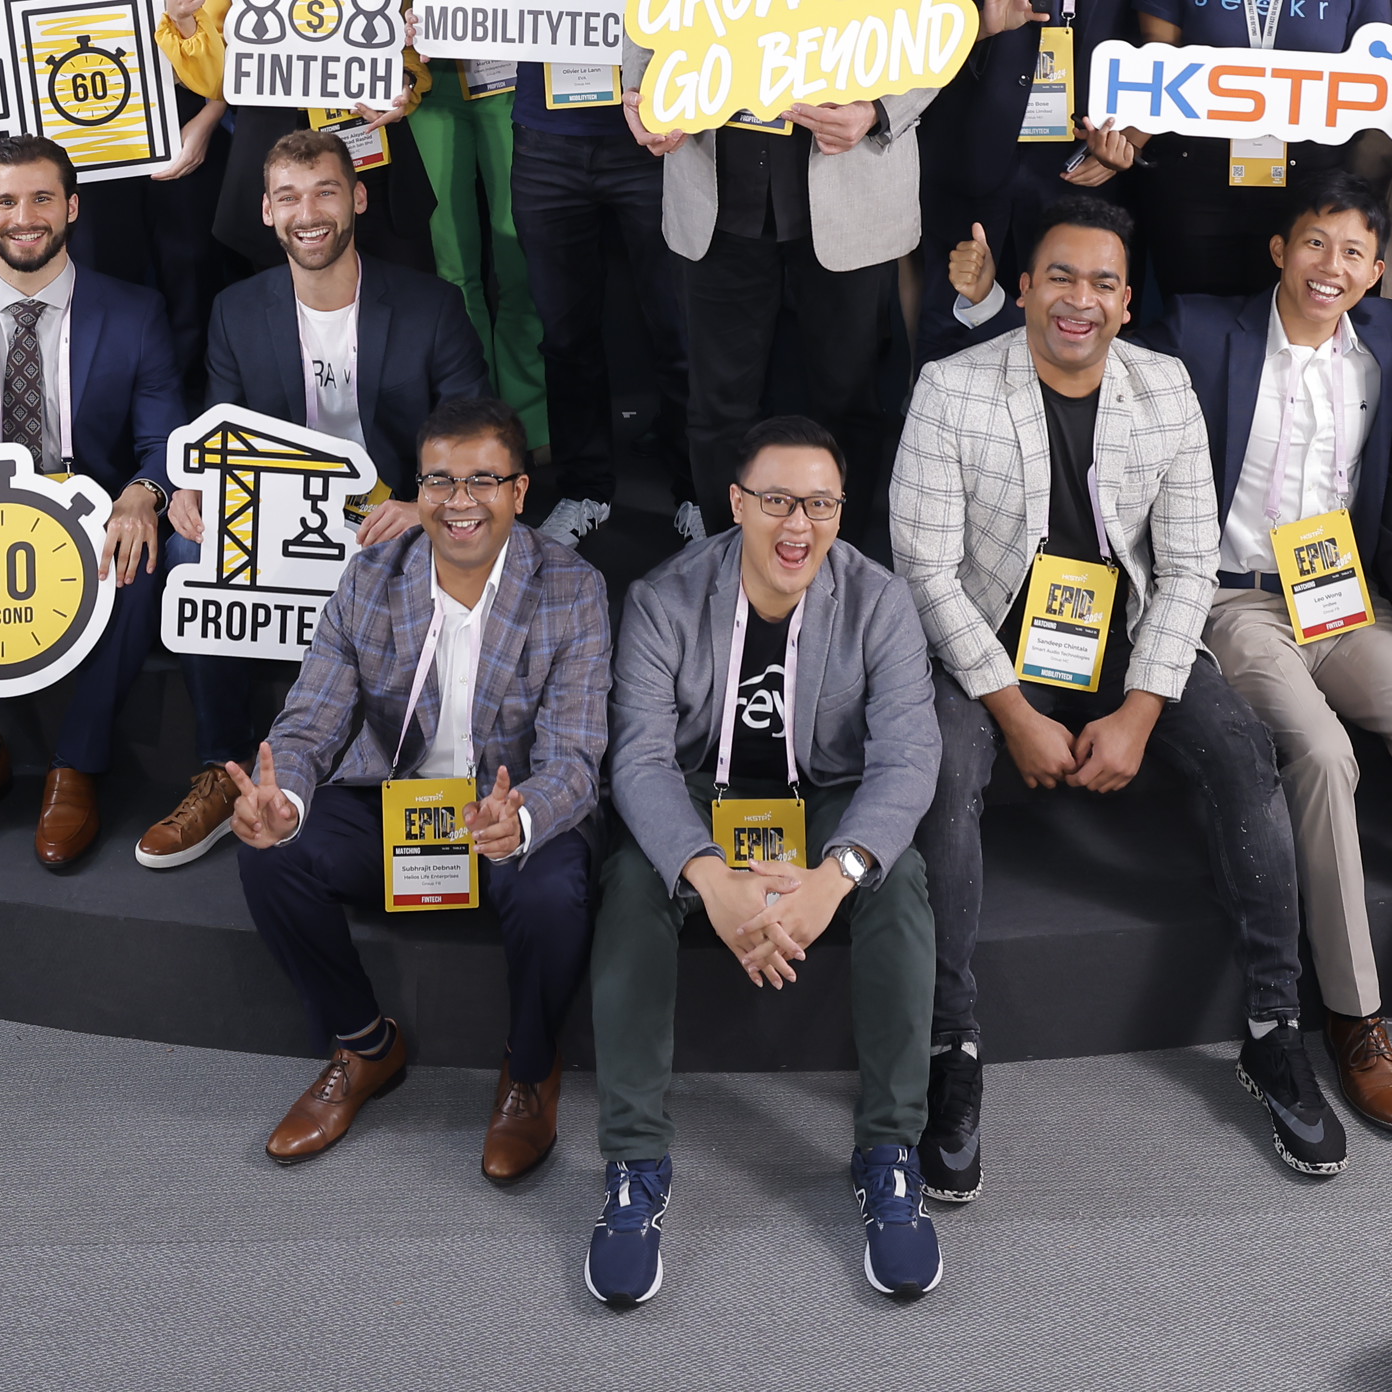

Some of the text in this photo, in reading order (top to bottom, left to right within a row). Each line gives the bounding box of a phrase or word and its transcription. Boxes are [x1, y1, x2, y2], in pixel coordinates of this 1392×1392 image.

[423, 5, 625, 48] MOBILITYTEC
[70, 70, 108, 104] 60
[233, 52, 394, 101] FINTECH
[652, 42, 733, 123] GO
[1106, 58, 1388, 129] HKSTP
[1293, 537, 1341, 577] EPIC
[1293, 581, 1316, 593] MATCHING
[1314, 590, 1342, 604] Leo Wong
[1045, 582, 1096, 620] EPIC
[176, 597, 314, 647] PROPTE
[1033, 619, 1057, 630] MATCHING
[1325, 620, 1345, 630] FINTECH
[1037, 638, 1088, 653] Sandeep Chintala
[1040, 669, 1073, 681] MOBILITYTECH
[404, 806, 455, 841] EPIC
[449, 827, 468, 842] 2024
[395, 847, 421, 855] MATCHING
[734, 827, 784, 861] EPIC
[401, 865, 431, 873] Subhrajit
[421, 895, 442, 904] FINTECH
